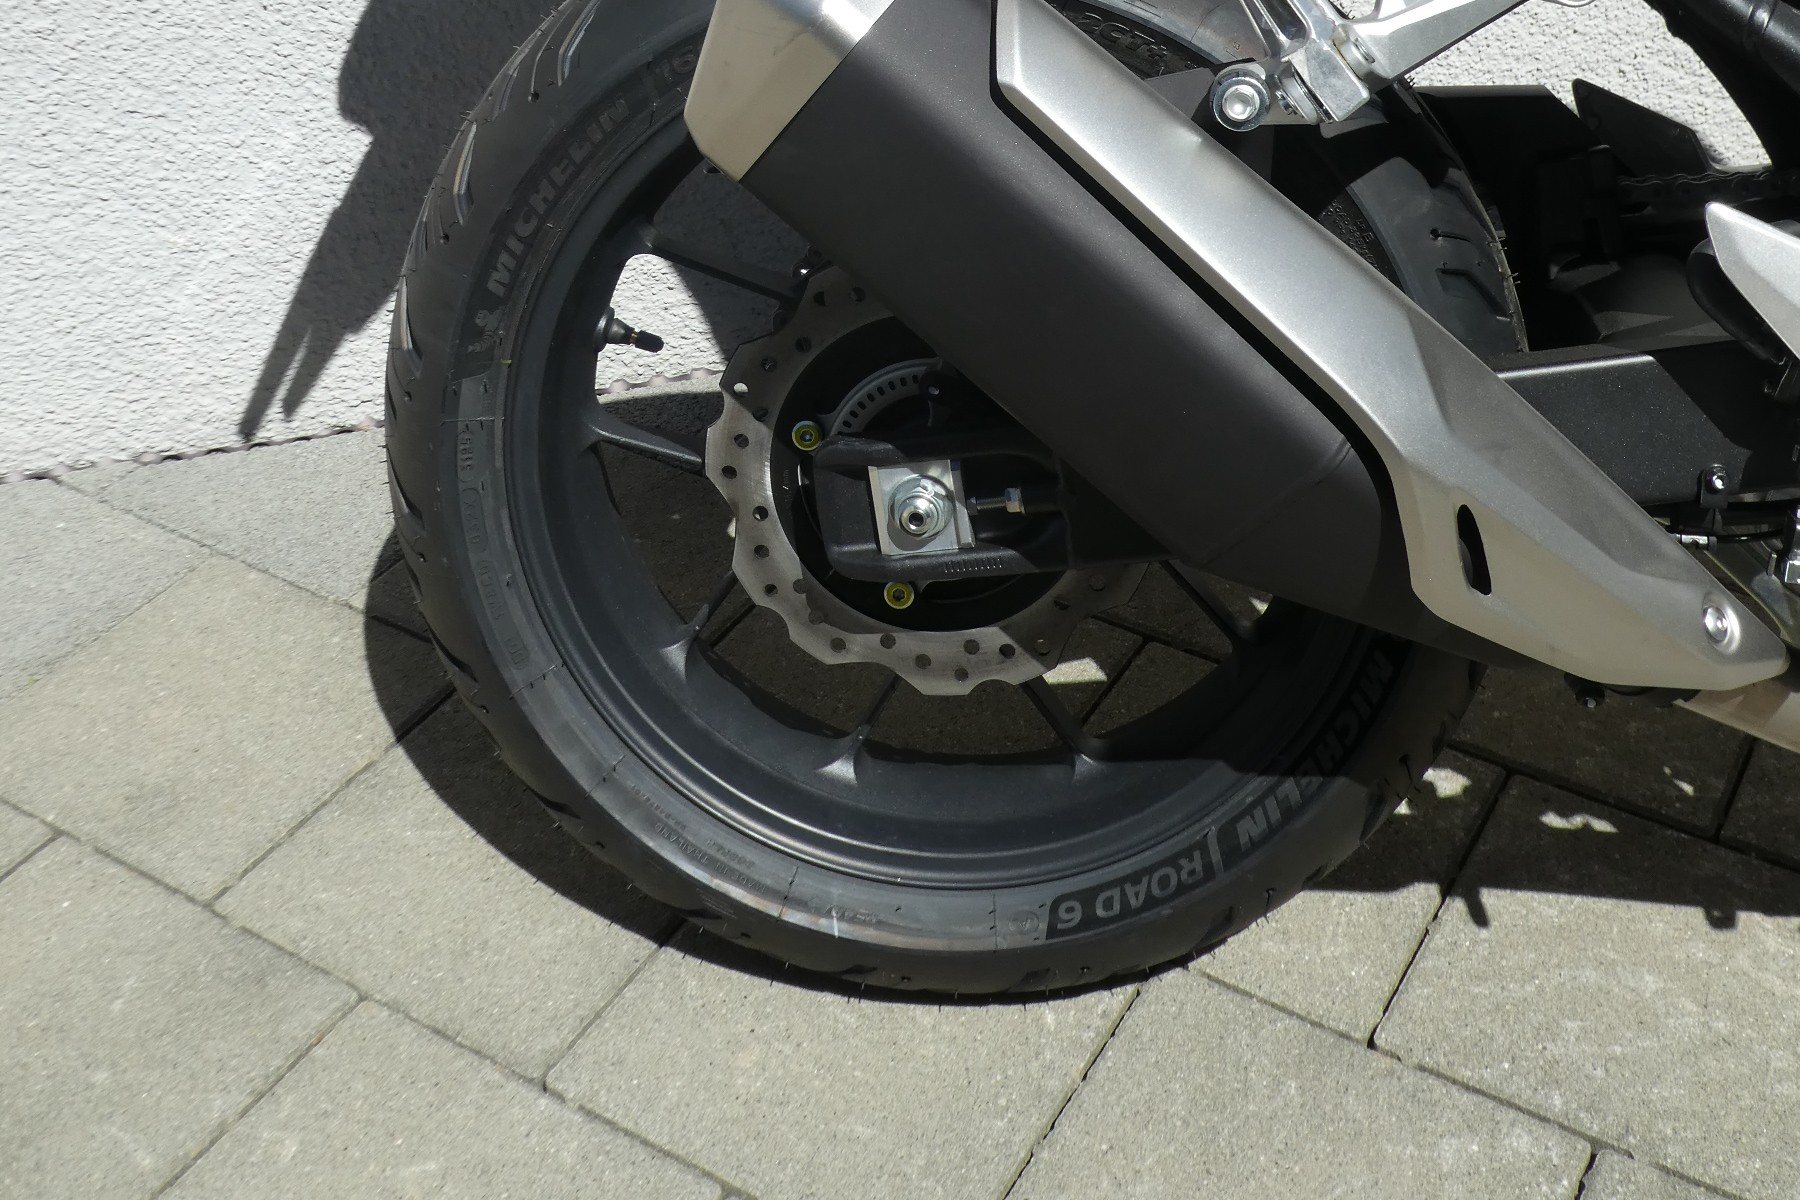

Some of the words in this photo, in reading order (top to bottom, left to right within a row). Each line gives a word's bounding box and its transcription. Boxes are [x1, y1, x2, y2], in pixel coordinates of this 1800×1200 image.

[487, 97, 630, 299] MICHELIN
[1235, 648, 1396, 852] MICHELIN
[653, 822, 708, 865] THAILAND
[1055, 898, 1084, 931] 6
[1094, 848, 1205, 920] ROAD
